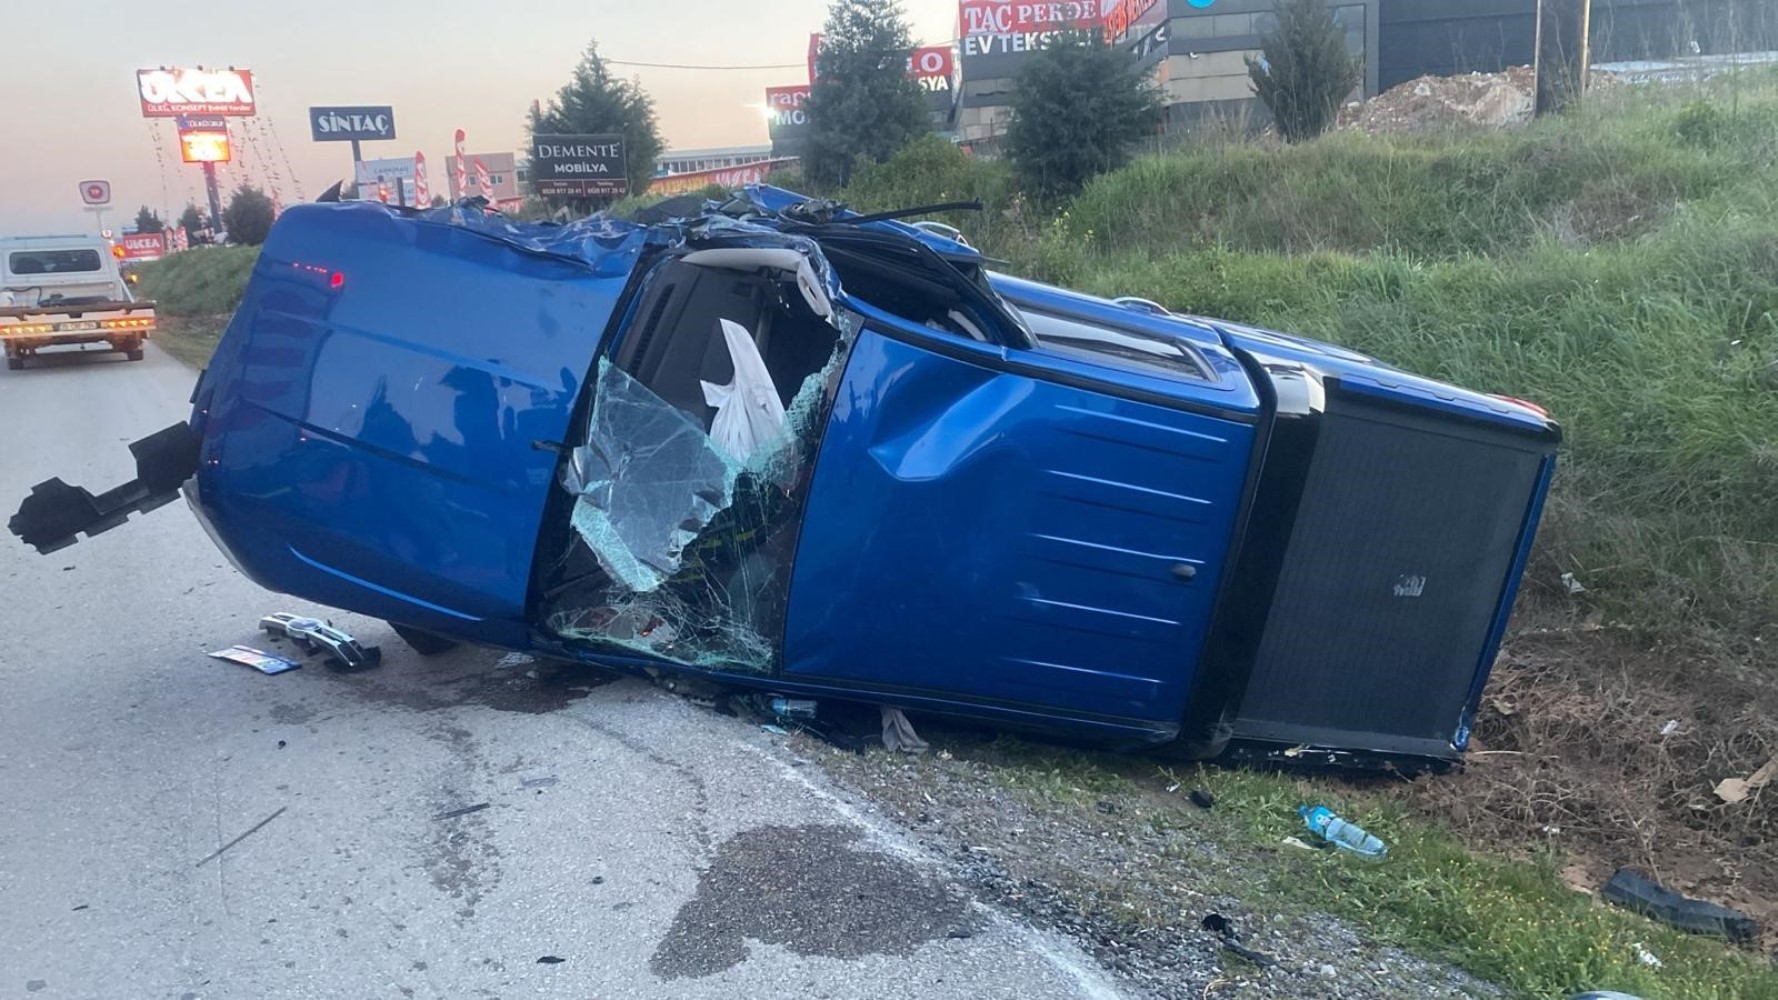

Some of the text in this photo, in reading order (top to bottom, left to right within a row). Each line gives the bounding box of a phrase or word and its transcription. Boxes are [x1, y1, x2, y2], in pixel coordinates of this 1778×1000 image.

[965, 36, 993, 55] EV
[318, 111, 389, 135] SİNTAÇ
[538, 142, 619, 158] DEMENTE
[554, 161, 608, 173] MOBİLYA
